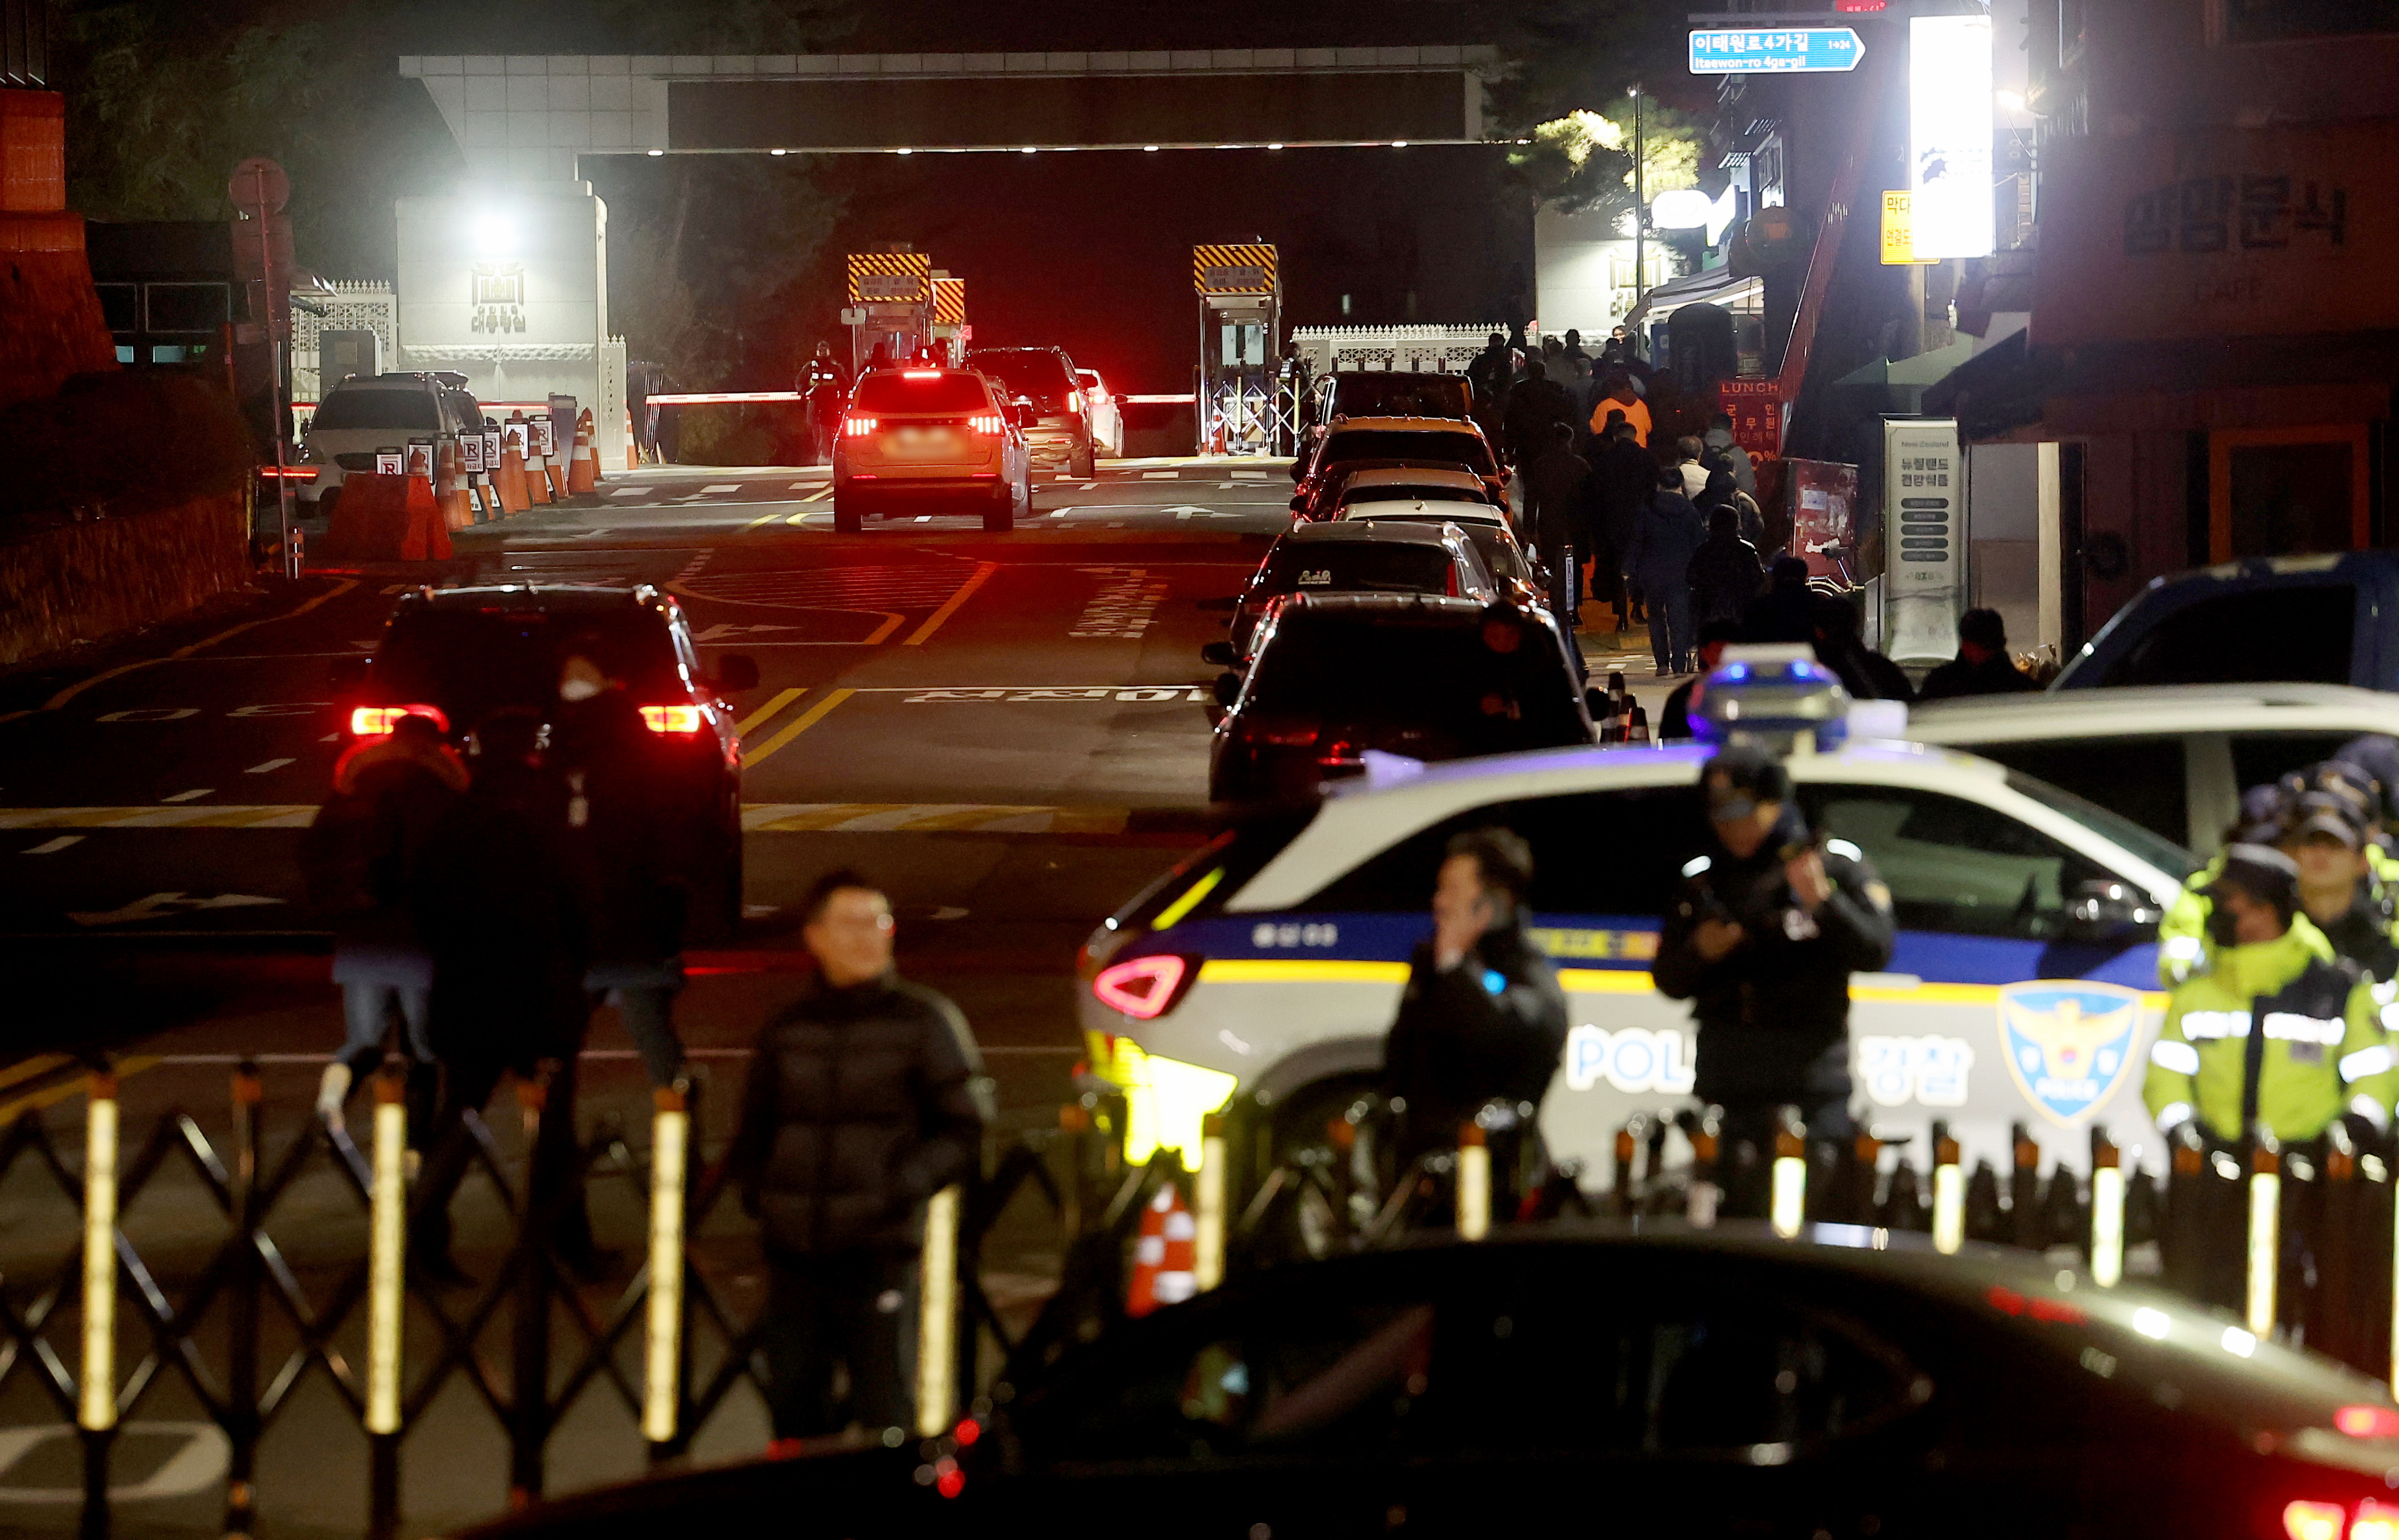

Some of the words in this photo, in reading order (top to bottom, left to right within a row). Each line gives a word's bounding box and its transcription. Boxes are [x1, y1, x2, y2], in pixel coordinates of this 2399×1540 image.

[1695, 33, 1808, 52] 이태원로4가길
[1695, 57, 1761, 68] Itaewon-ro
[1764, 55, 1806, 69] 4ga-gil
[1721, 382, 1779, 393] LUNCH
[1859, 1035, 1974, 1105] 경찰
